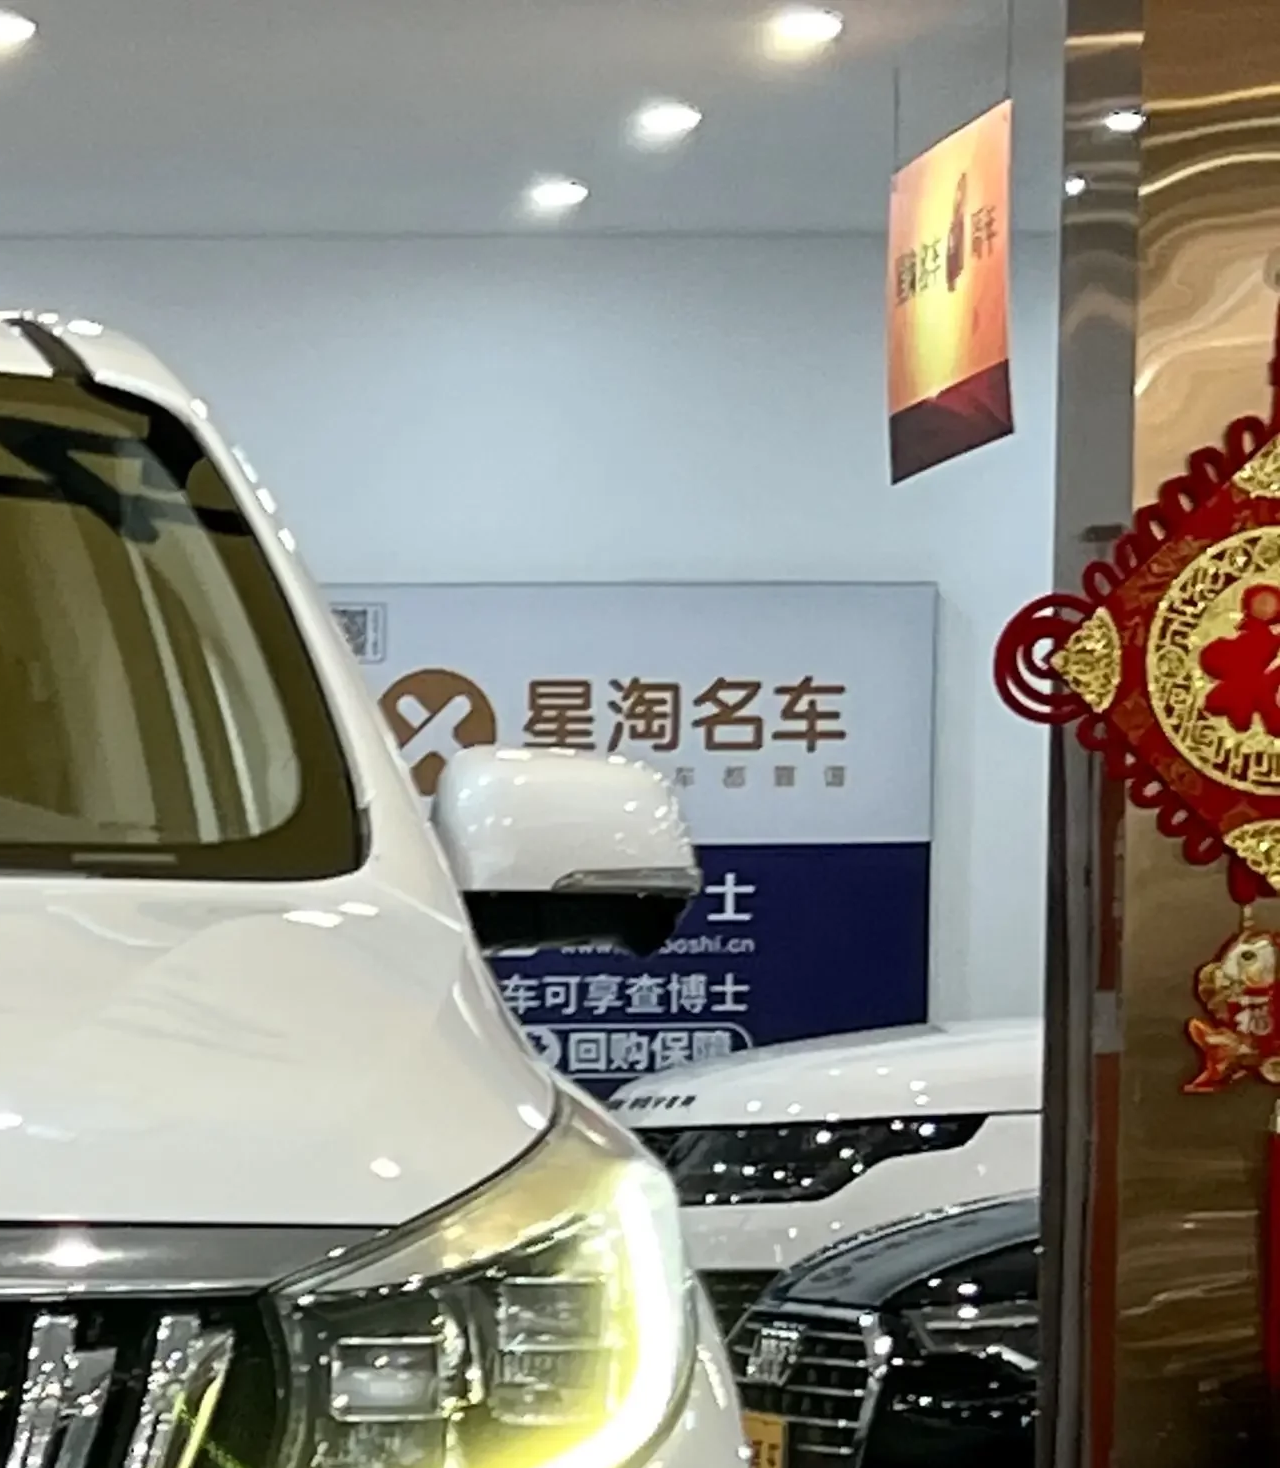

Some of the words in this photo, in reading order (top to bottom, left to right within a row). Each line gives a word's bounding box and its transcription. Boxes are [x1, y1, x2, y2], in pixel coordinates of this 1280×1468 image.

[522, 676, 847, 753] 星淘名车
[500, 973, 750, 1015] 车可享查博士
[568, 1030, 733, 1072] 回购保障
